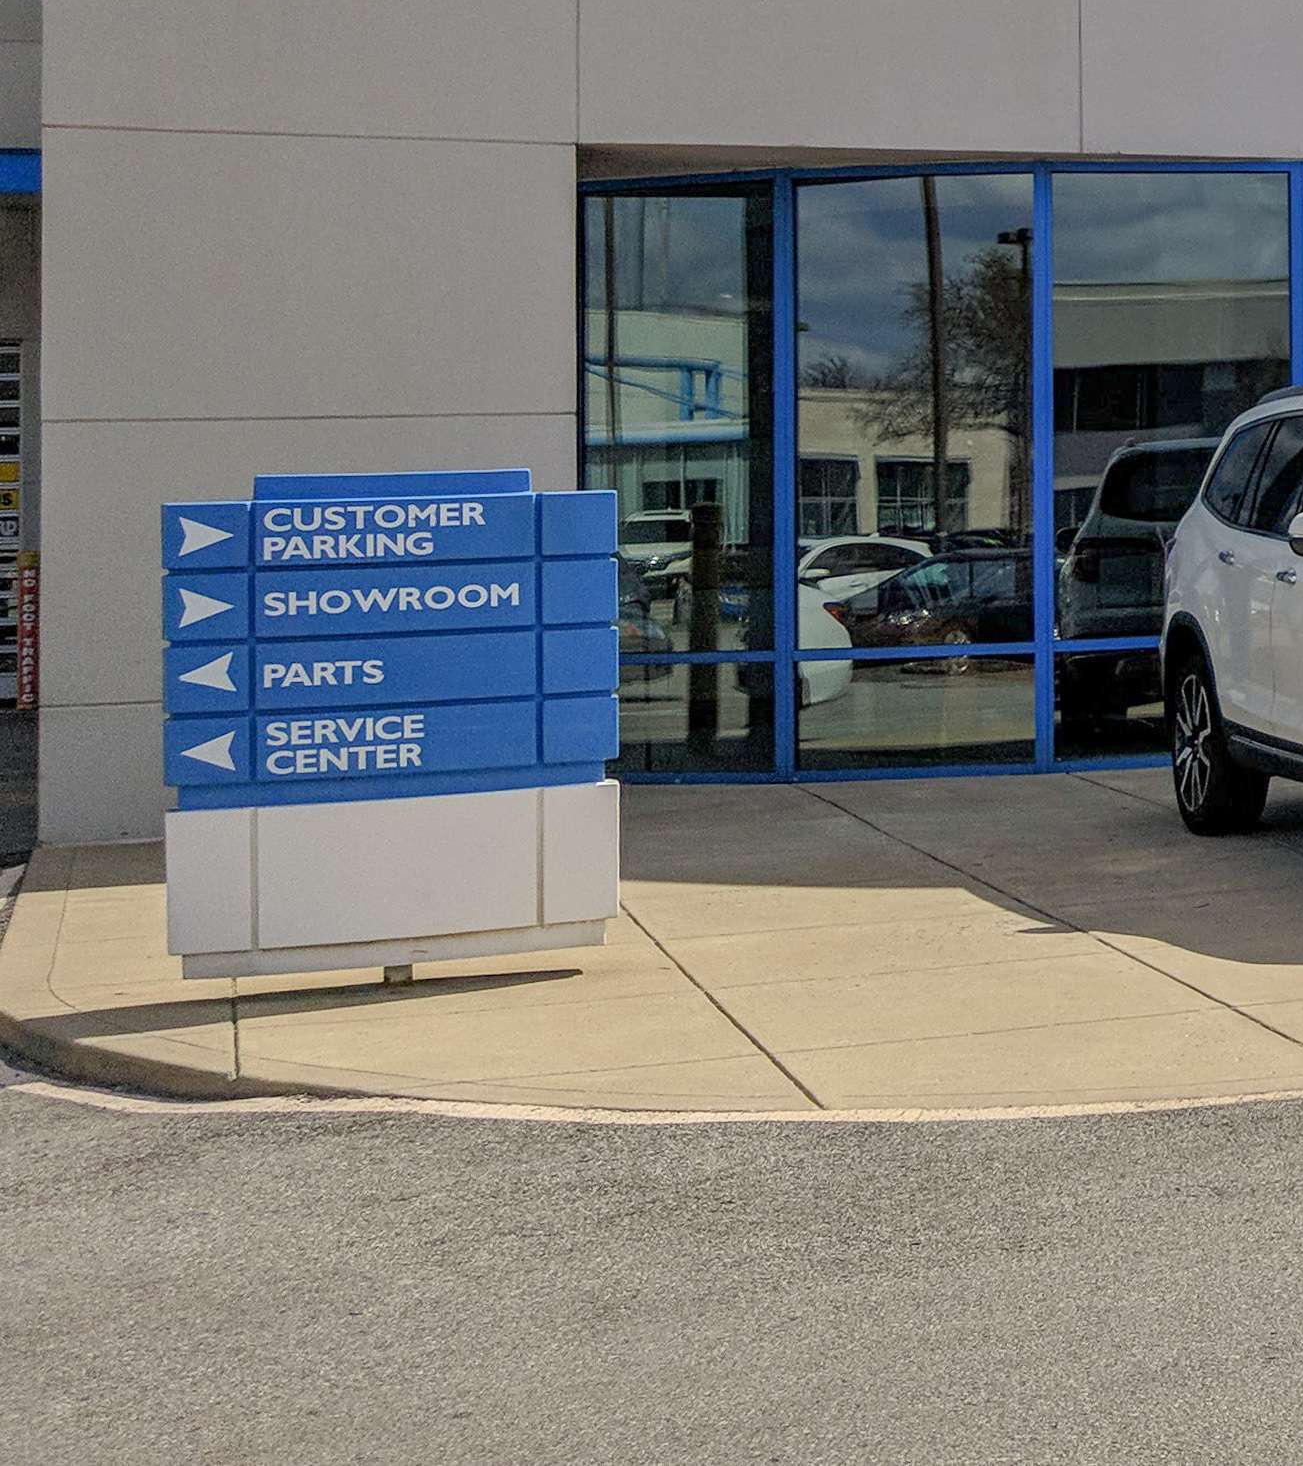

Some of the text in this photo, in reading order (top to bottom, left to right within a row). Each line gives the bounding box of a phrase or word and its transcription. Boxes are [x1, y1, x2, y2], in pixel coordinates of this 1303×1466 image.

[263, 502, 486, 532] CUSTOMER
[263, 532, 434, 561] PARKING
[263, 583, 520, 617] SHOWROOM
[263, 659, 385, 688] PARTS
[265, 714, 425, 746] SERVICE
[265, 743, 423, 775] CENTER
